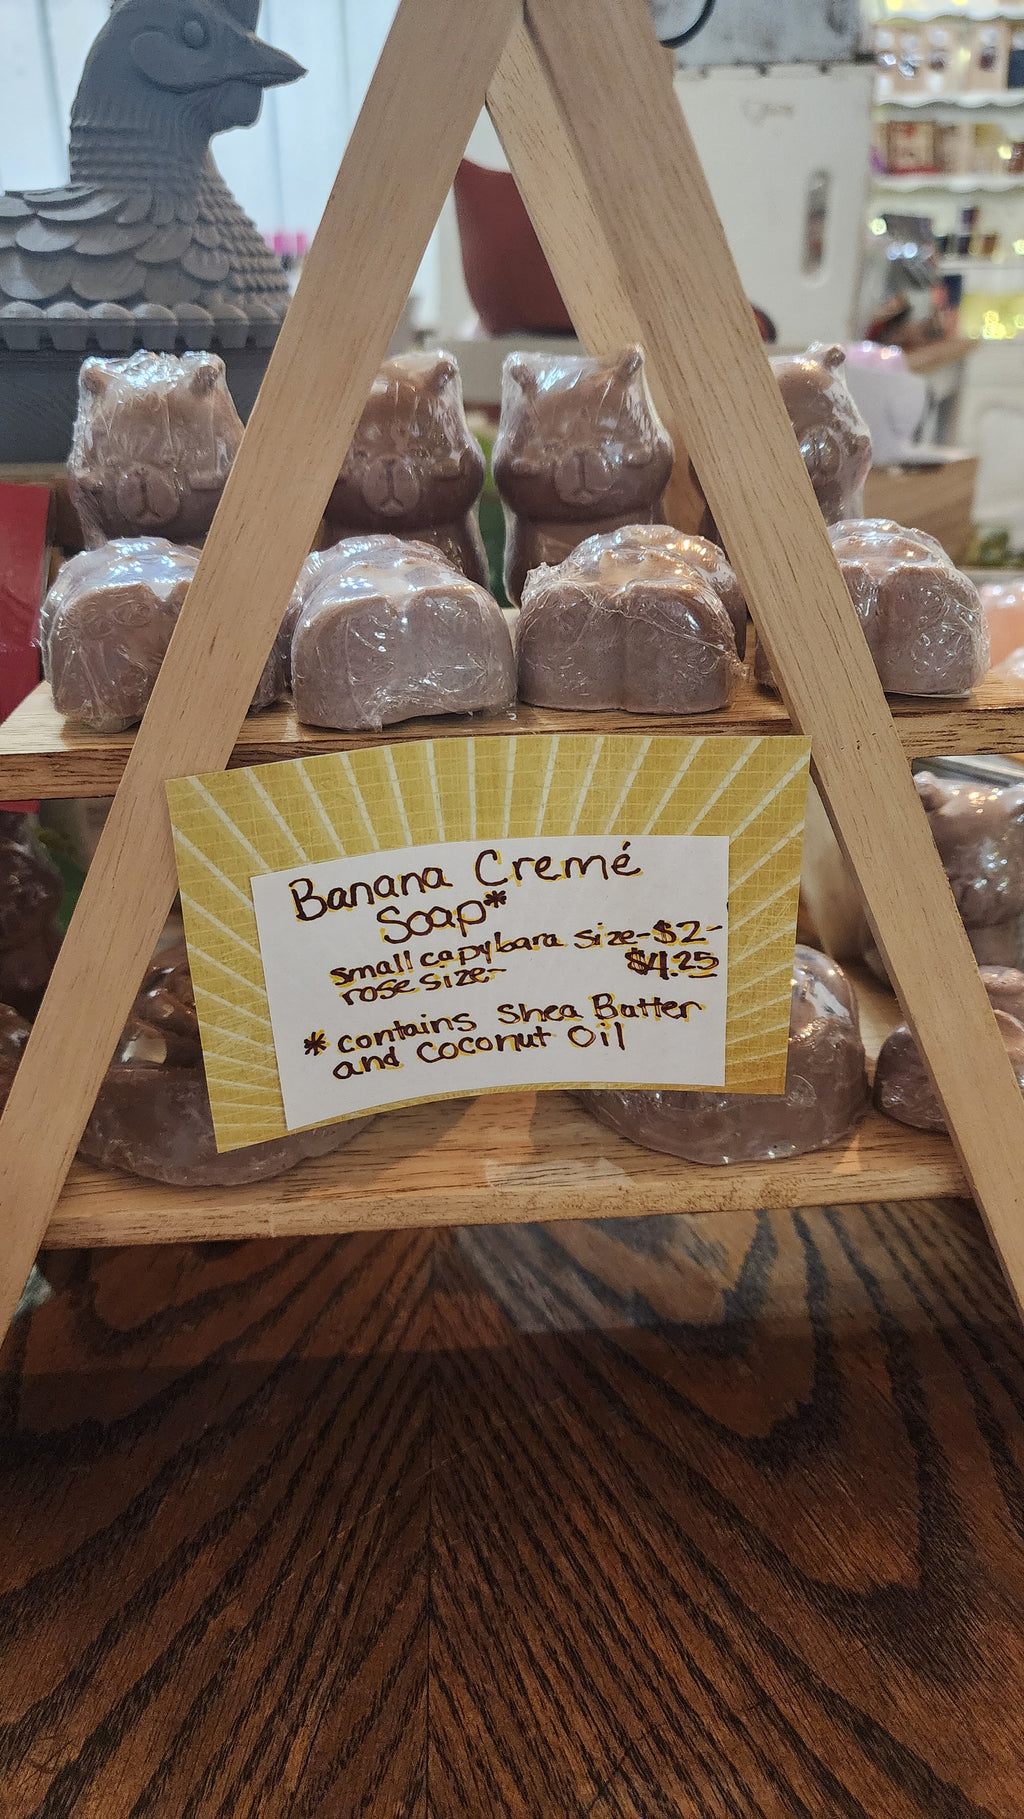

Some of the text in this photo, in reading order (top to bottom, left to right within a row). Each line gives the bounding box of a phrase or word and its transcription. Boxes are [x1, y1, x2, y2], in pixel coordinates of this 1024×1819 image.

[288, 841, 642, 922] Banana Cremé
[329, 949, 414, 989] small
[420, 931, 565, 968] capybara
[340, 977, 416, 1006] rose
[624, 946, 720, 981] $4.25
[332, 1021, 626, 1080] and Coconut Oil
[337, 1013, 478, 1054] contains
[496, 1002, 585, 1027] Shea
